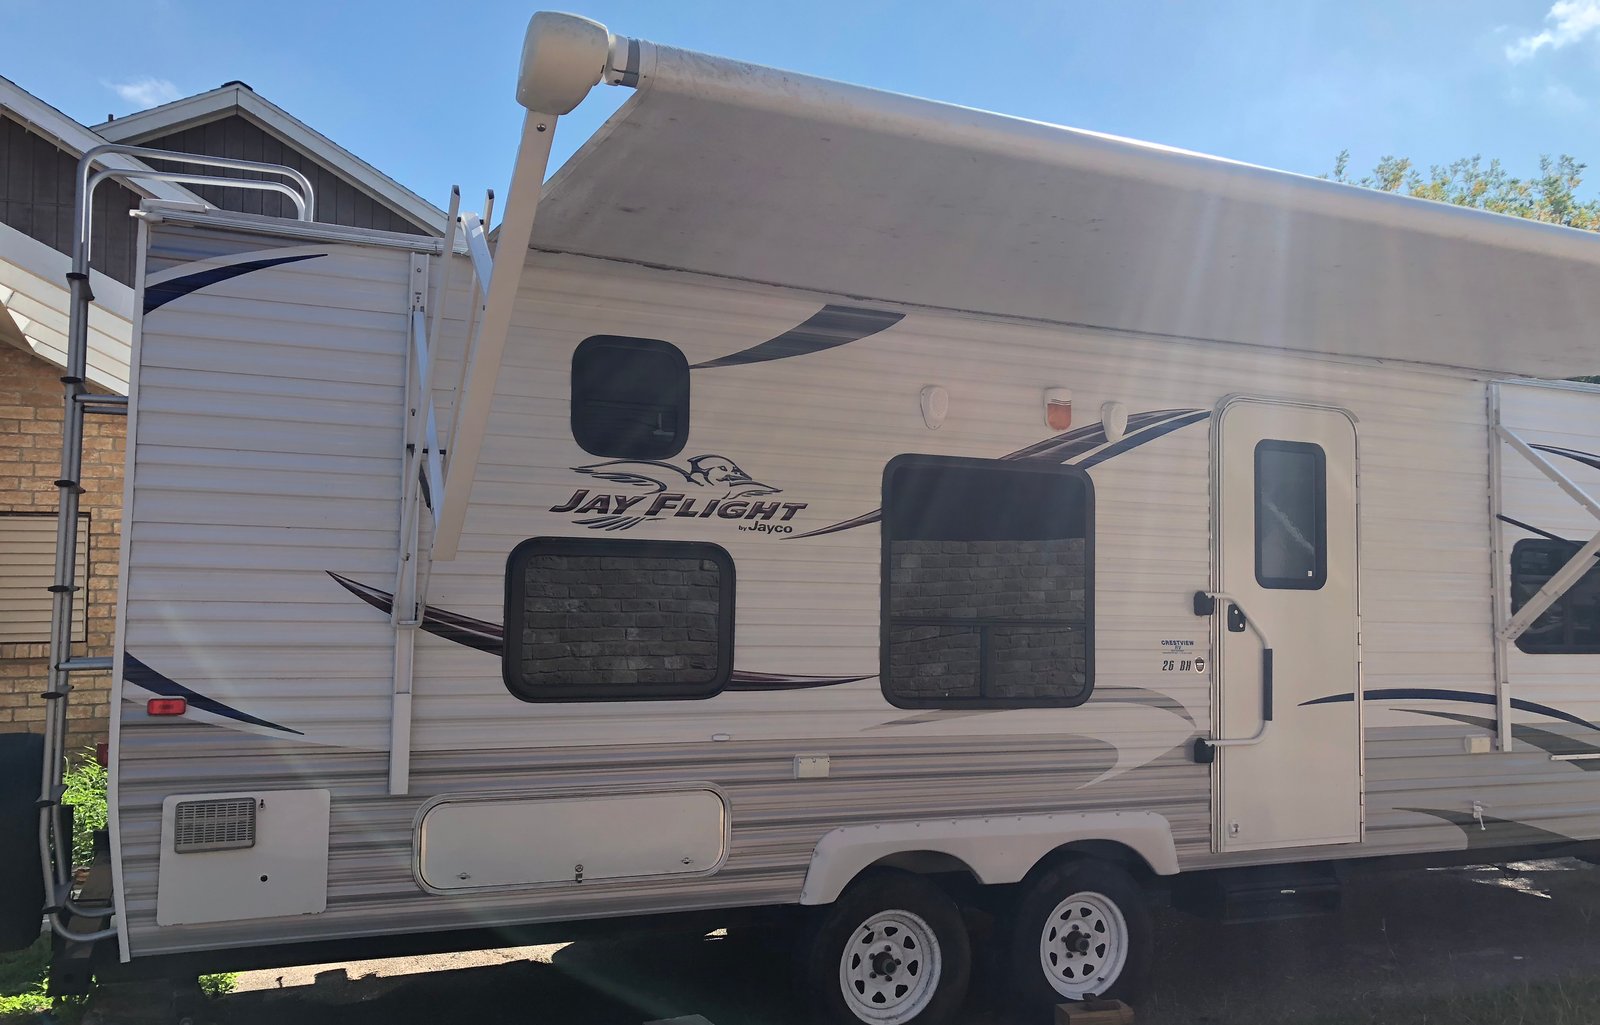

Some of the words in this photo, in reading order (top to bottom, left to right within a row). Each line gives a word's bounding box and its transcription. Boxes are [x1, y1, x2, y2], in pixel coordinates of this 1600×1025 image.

[548, 489, 647, 515] JAY
[645, 493, 809, 521] FLIGHT
[738, 524, 747, 532] by
[748, 520, 793, 534] Jayco
[1162, 660, 1175, 671] 26
[1179, 660, 1192, 671] BH
